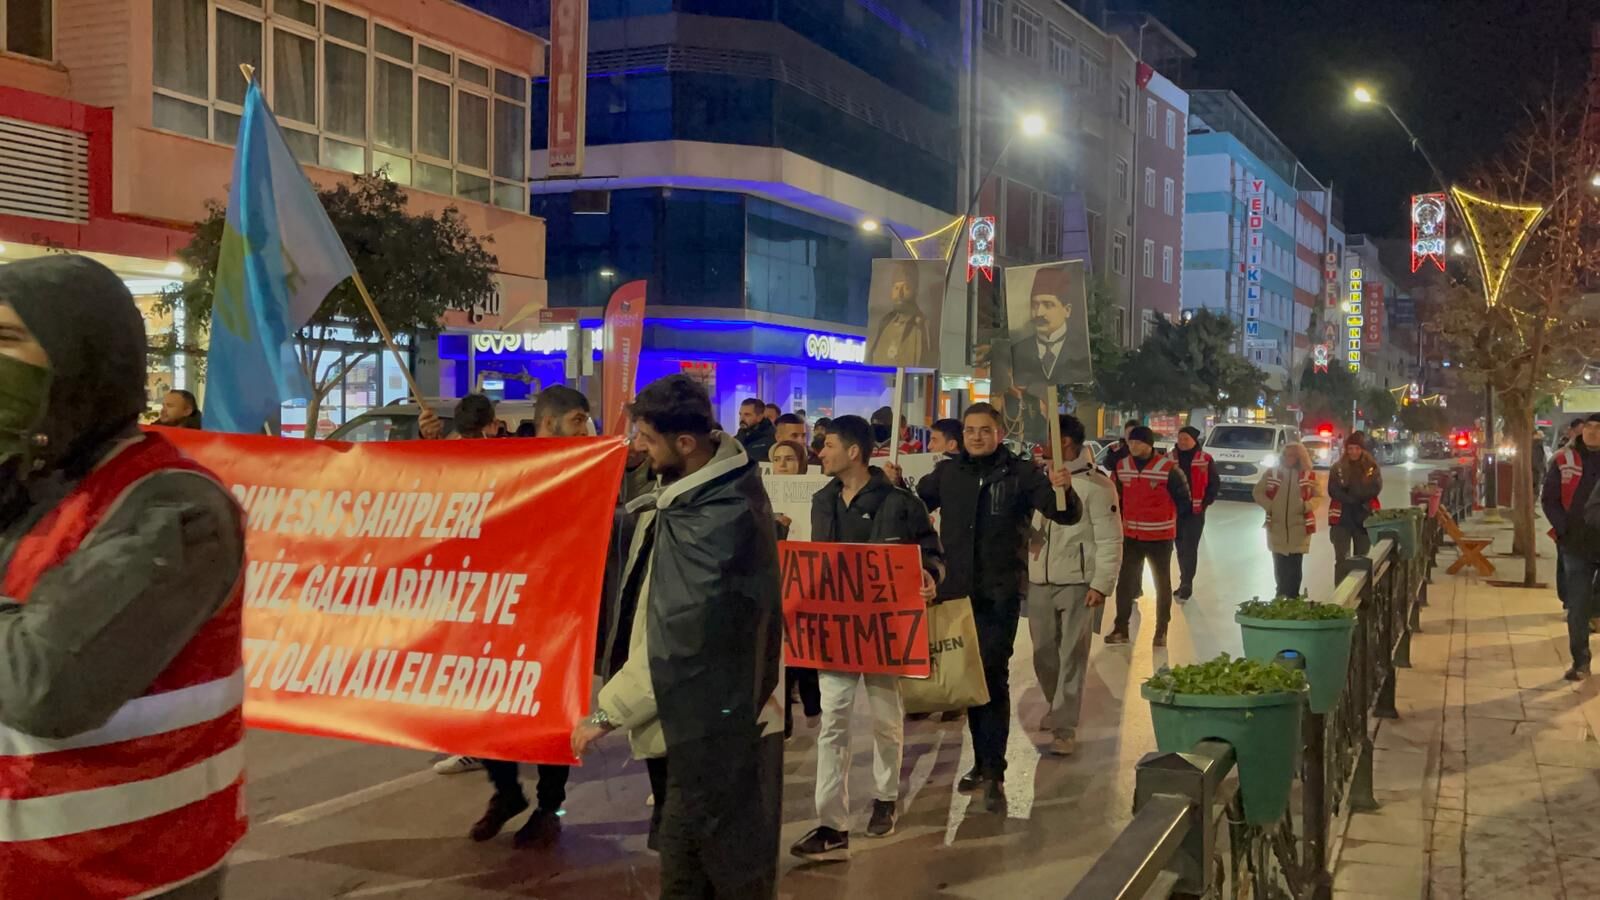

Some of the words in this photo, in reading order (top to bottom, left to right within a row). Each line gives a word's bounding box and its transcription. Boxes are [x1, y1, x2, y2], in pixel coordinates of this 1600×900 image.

[277, 488, 351, 538] ESAS
[347, 479, 496, 539] SAHİPLERİ
[482, 573, 527, 625] VE
[270, 641, 352, 696] OLAN
[342, 638, 542, 717] AİLELERİDİR.
